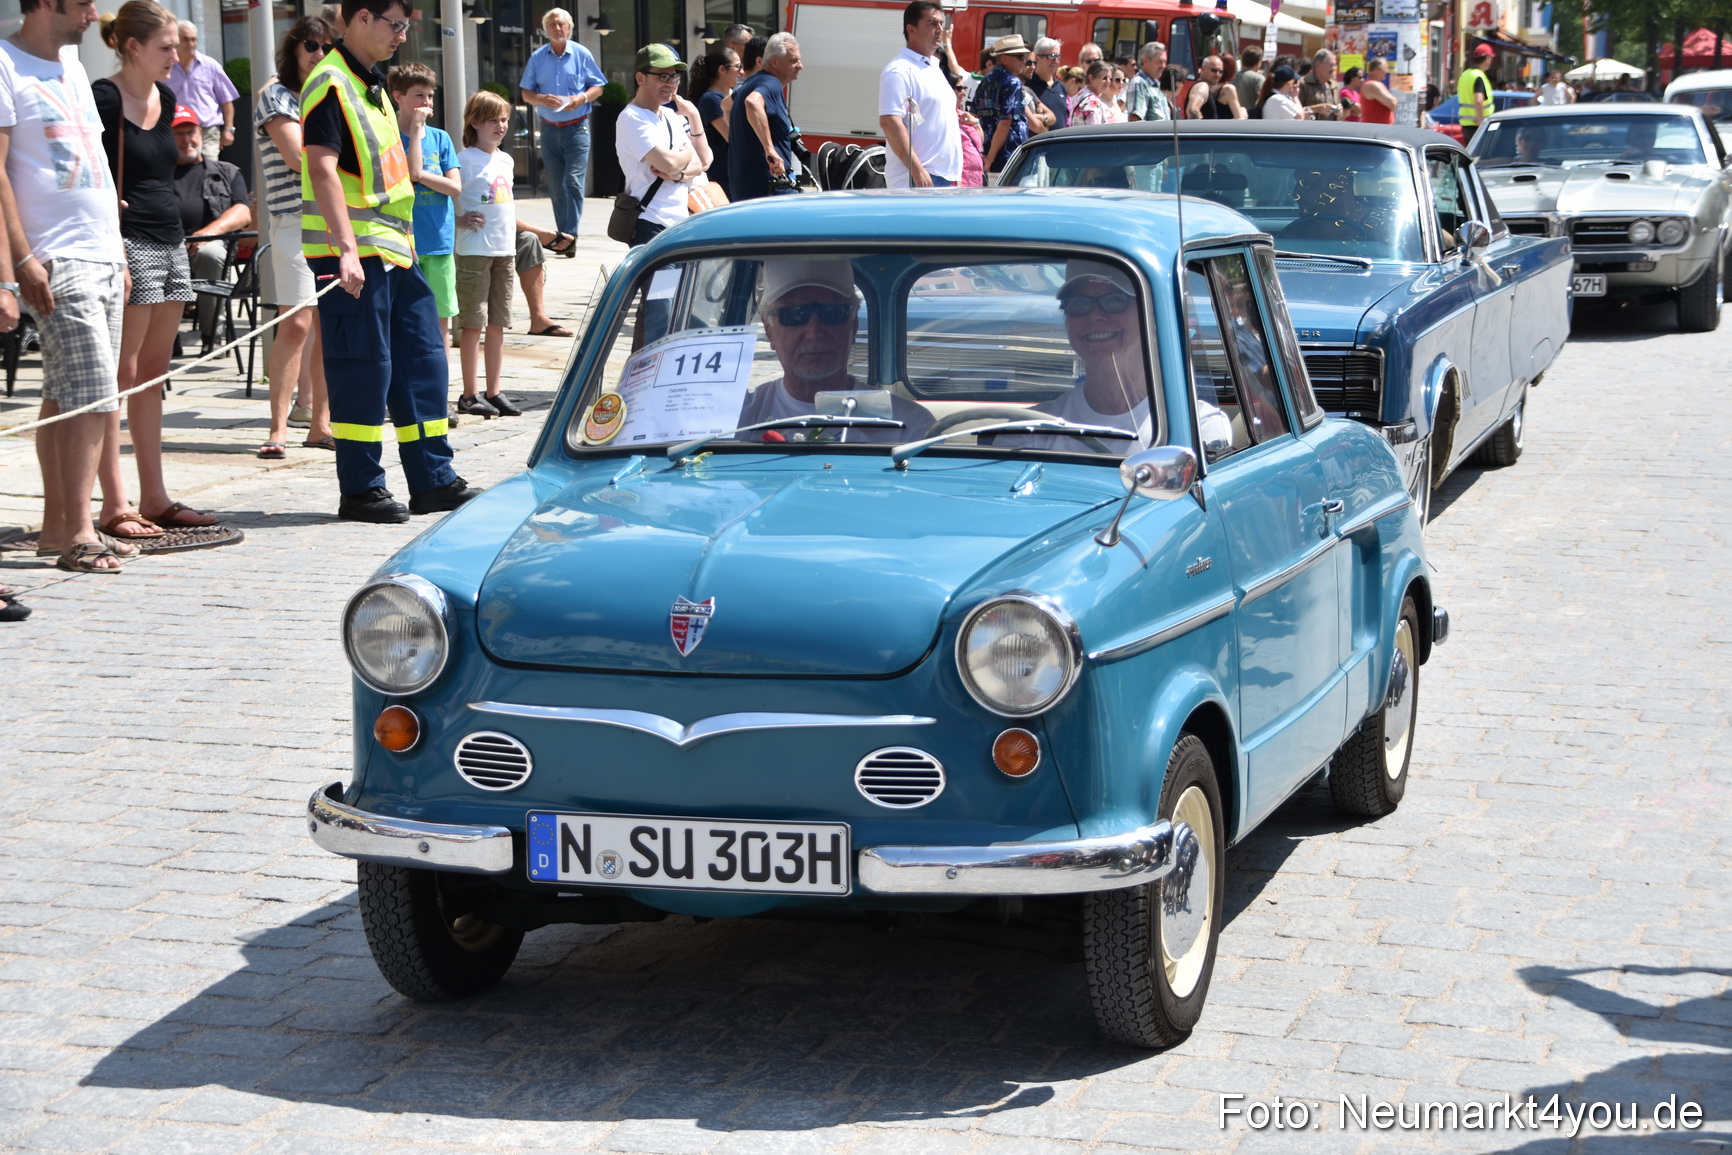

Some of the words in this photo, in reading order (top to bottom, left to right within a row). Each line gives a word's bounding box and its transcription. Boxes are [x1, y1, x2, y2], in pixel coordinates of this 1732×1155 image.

[674, 351, 723, 376] 114
[539, 853, 549, 868] D
[561, 822, 591, 874] N
[628, 825, 694, 880] SU
[707, 828, 841, 885] 303H
